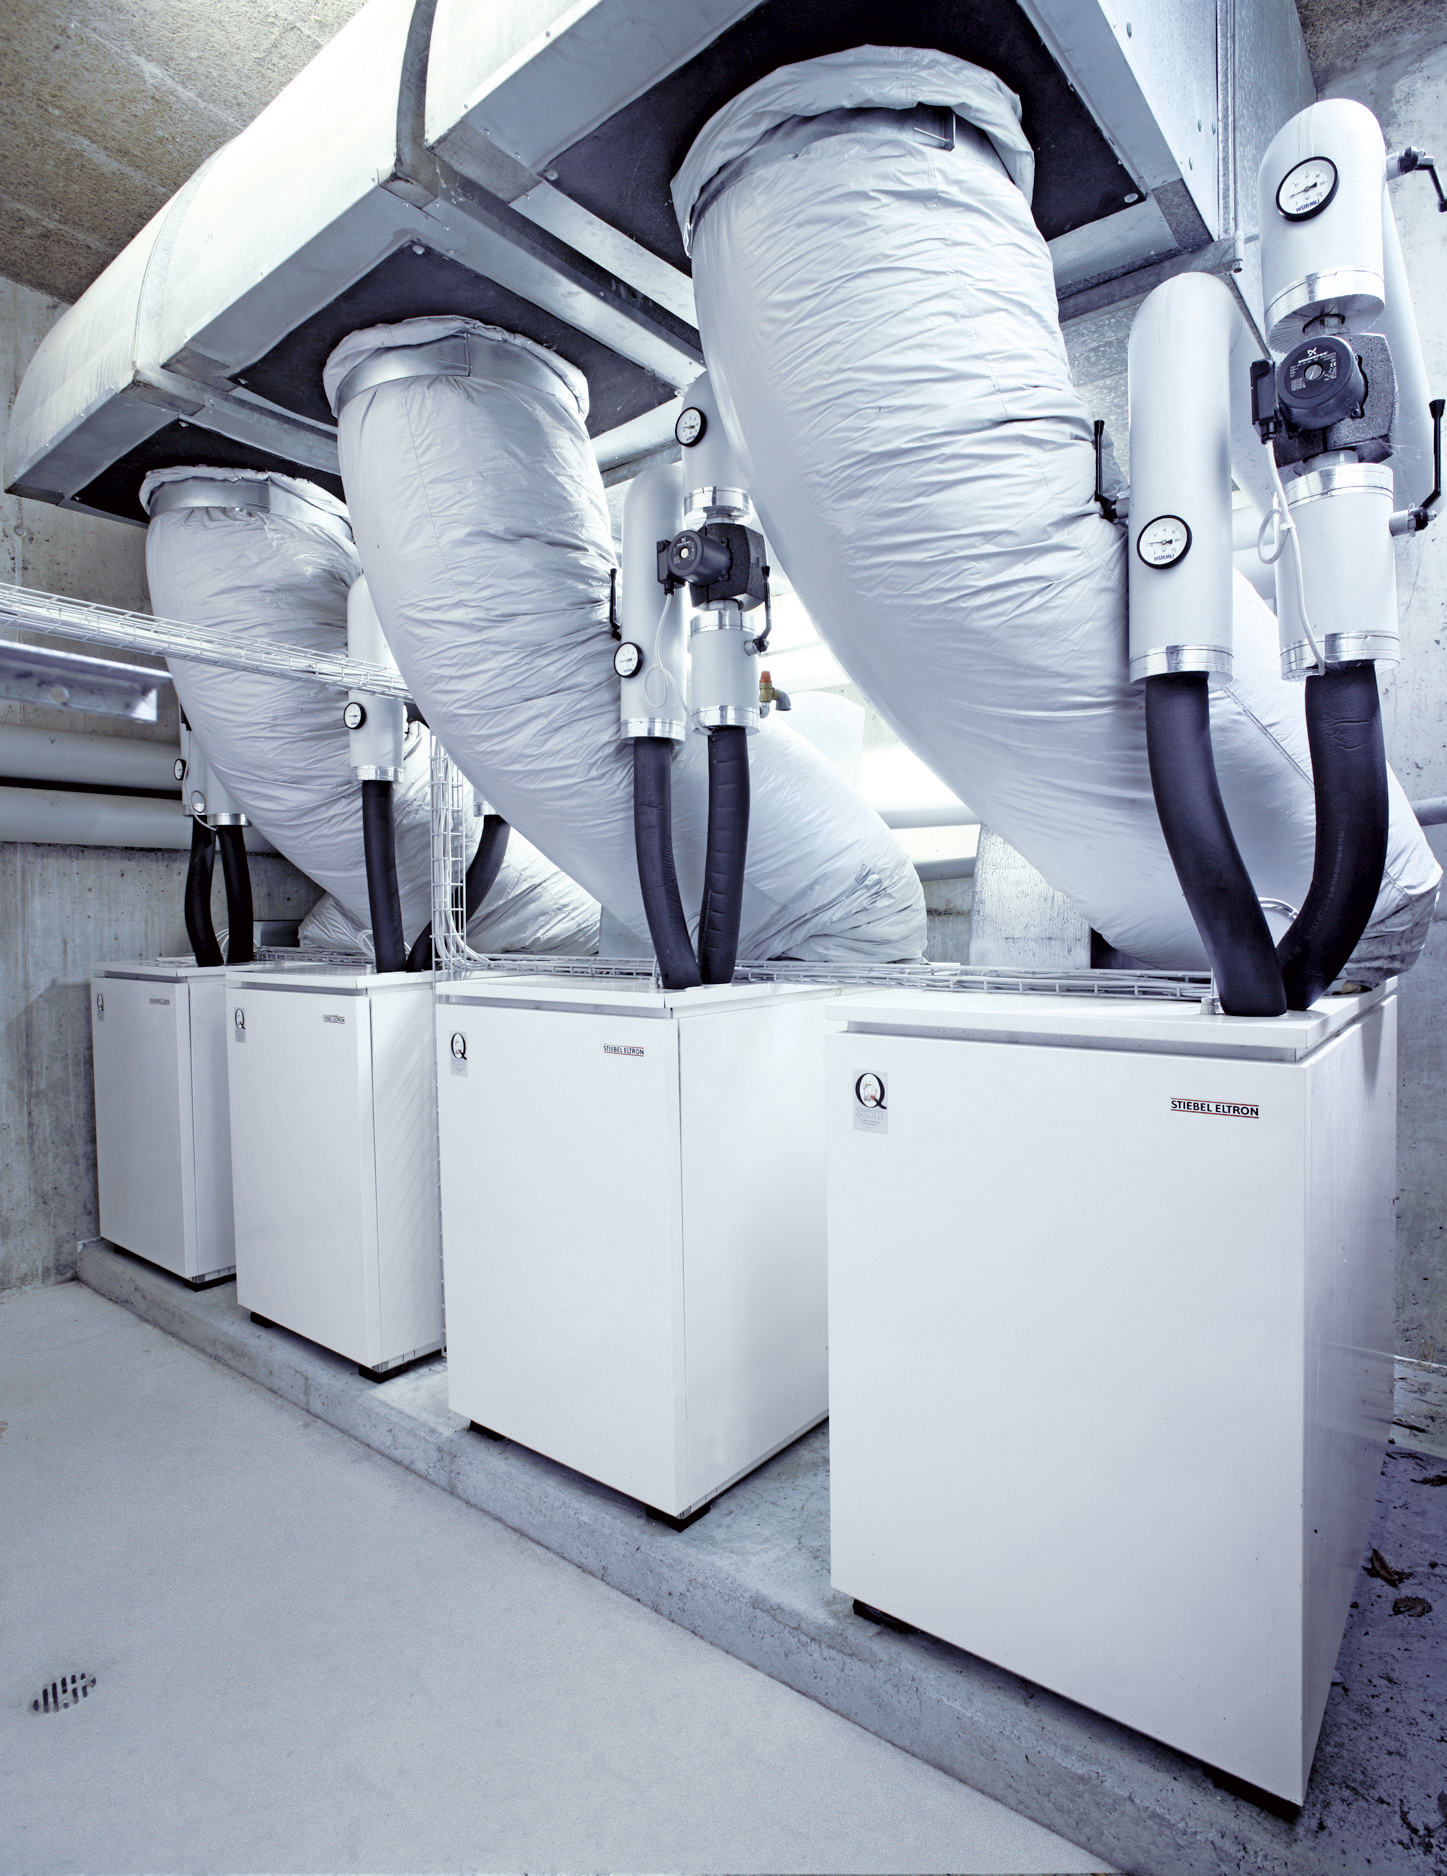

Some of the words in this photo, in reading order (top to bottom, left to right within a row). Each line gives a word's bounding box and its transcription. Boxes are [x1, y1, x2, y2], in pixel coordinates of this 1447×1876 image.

[96, 993, 105, 1011] Q
[234, 1008, 246, 1030] Q
[450, 1032, 468, 1061] Q
[603, 1045, 623, 1054] STIEBEL
[623, 1047, 645, 1055] ELTRON
[854, 1072, 888, 1110] Q
[1170, 1100, 1213, 1113] STIEBEL
[1215, 1104, 1259, 1116] ELTRON
